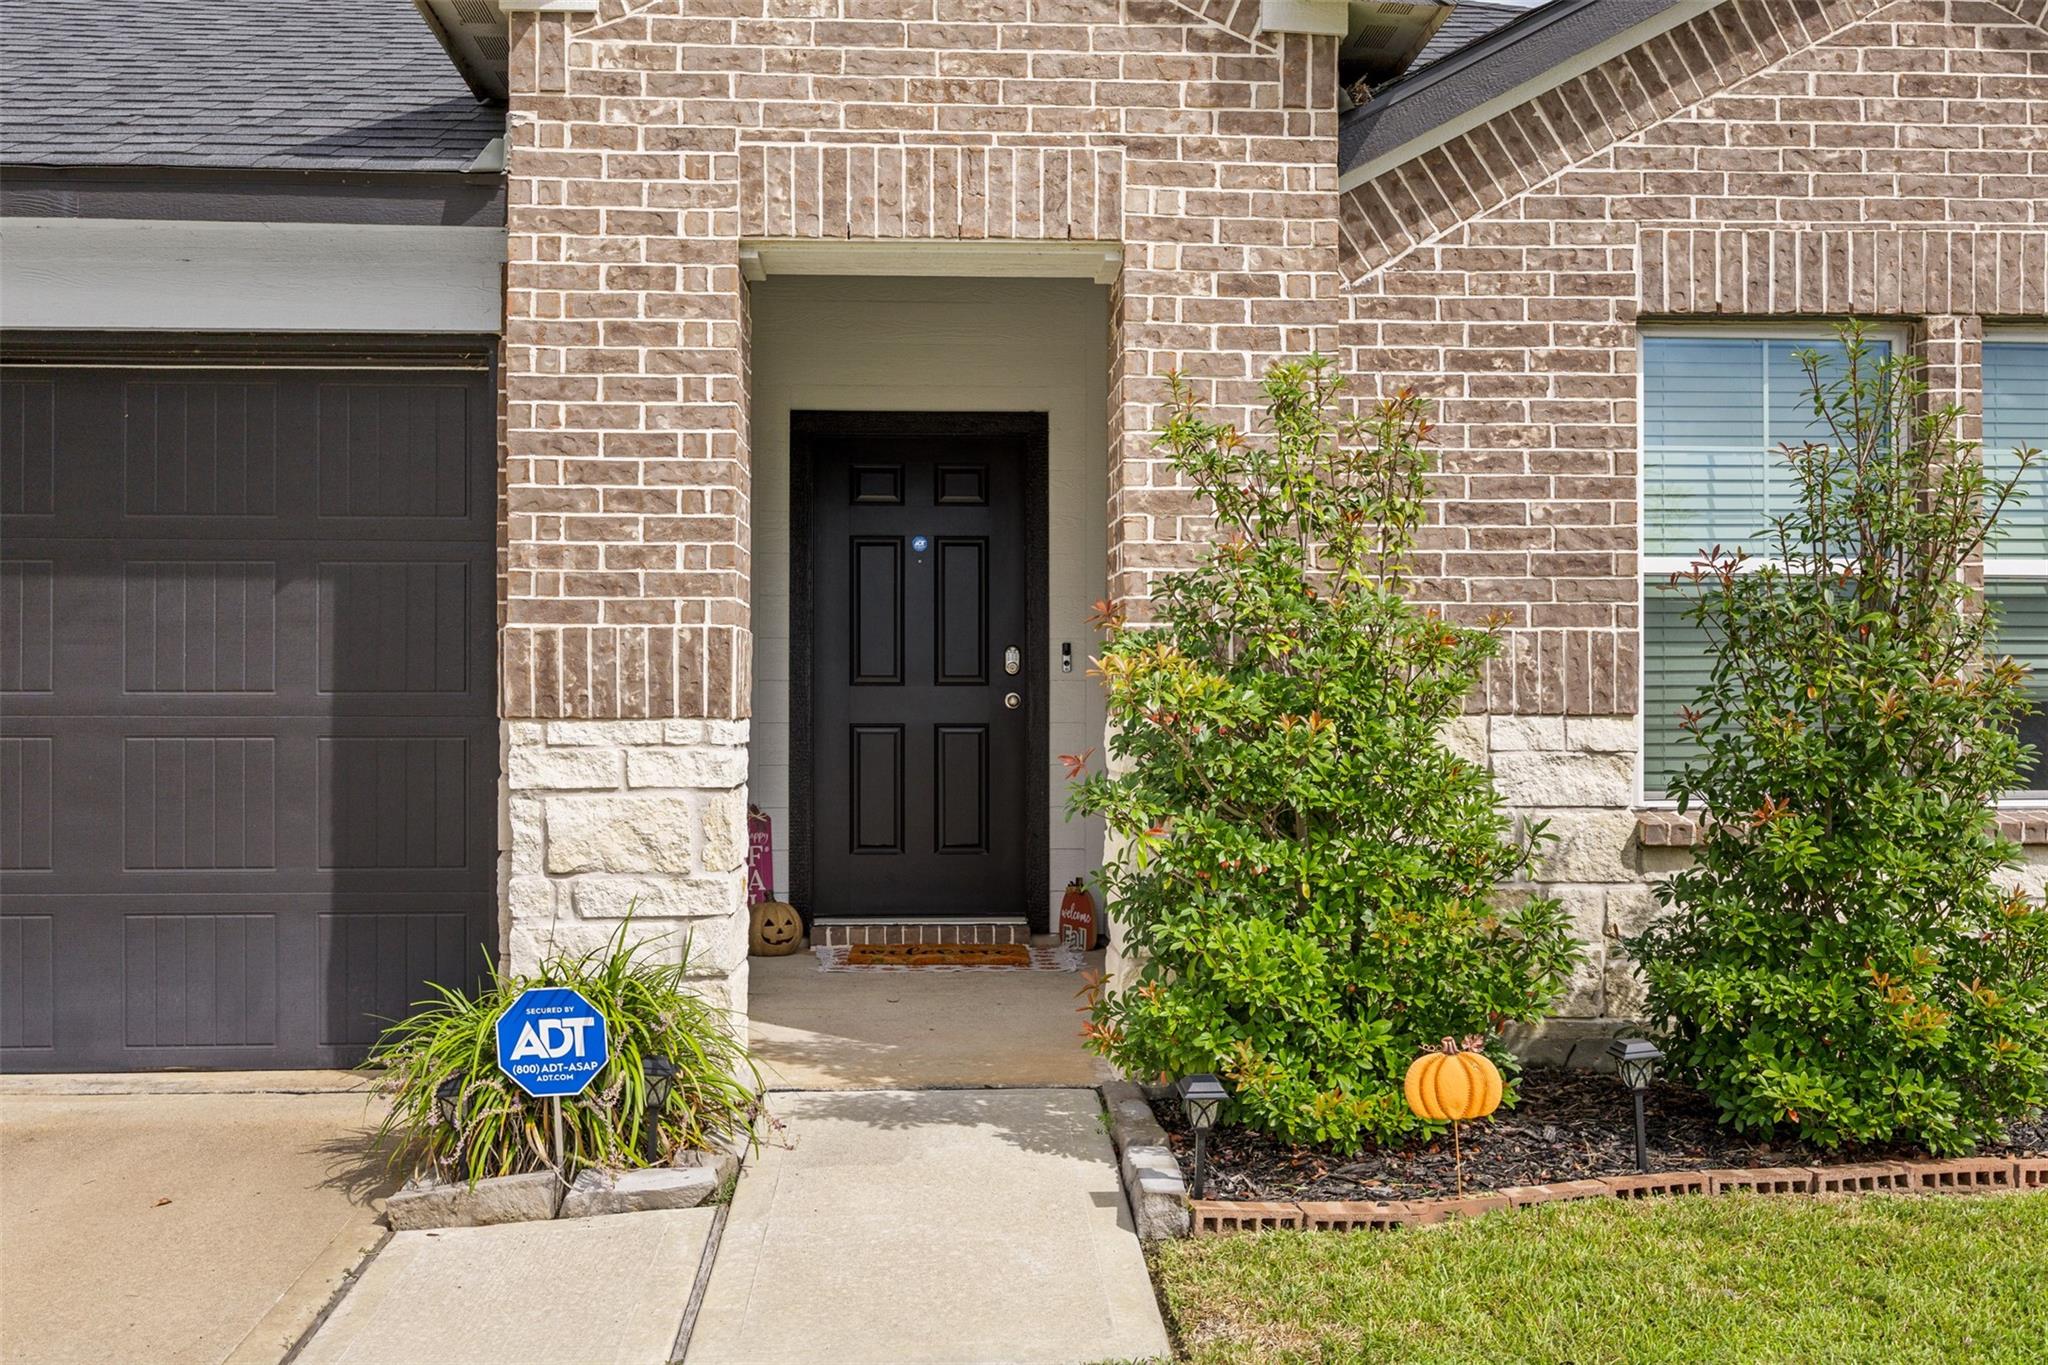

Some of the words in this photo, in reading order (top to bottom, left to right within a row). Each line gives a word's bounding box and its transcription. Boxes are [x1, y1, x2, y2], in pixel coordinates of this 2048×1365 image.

[749, 832, 769, 844] appy
[1061, 902, 1092, 923] welcome
[1063, 924, 1087, 951] Fall
[526, 1007, 562, 1015] SECURED
[510, 1017, 594, 1060] ADT
[512, 1063, 539, 1075] (800)
[541, 1061, 598, 1073] ADT-ASAP
[536, 1074, 574, 1082] ADT.COM
